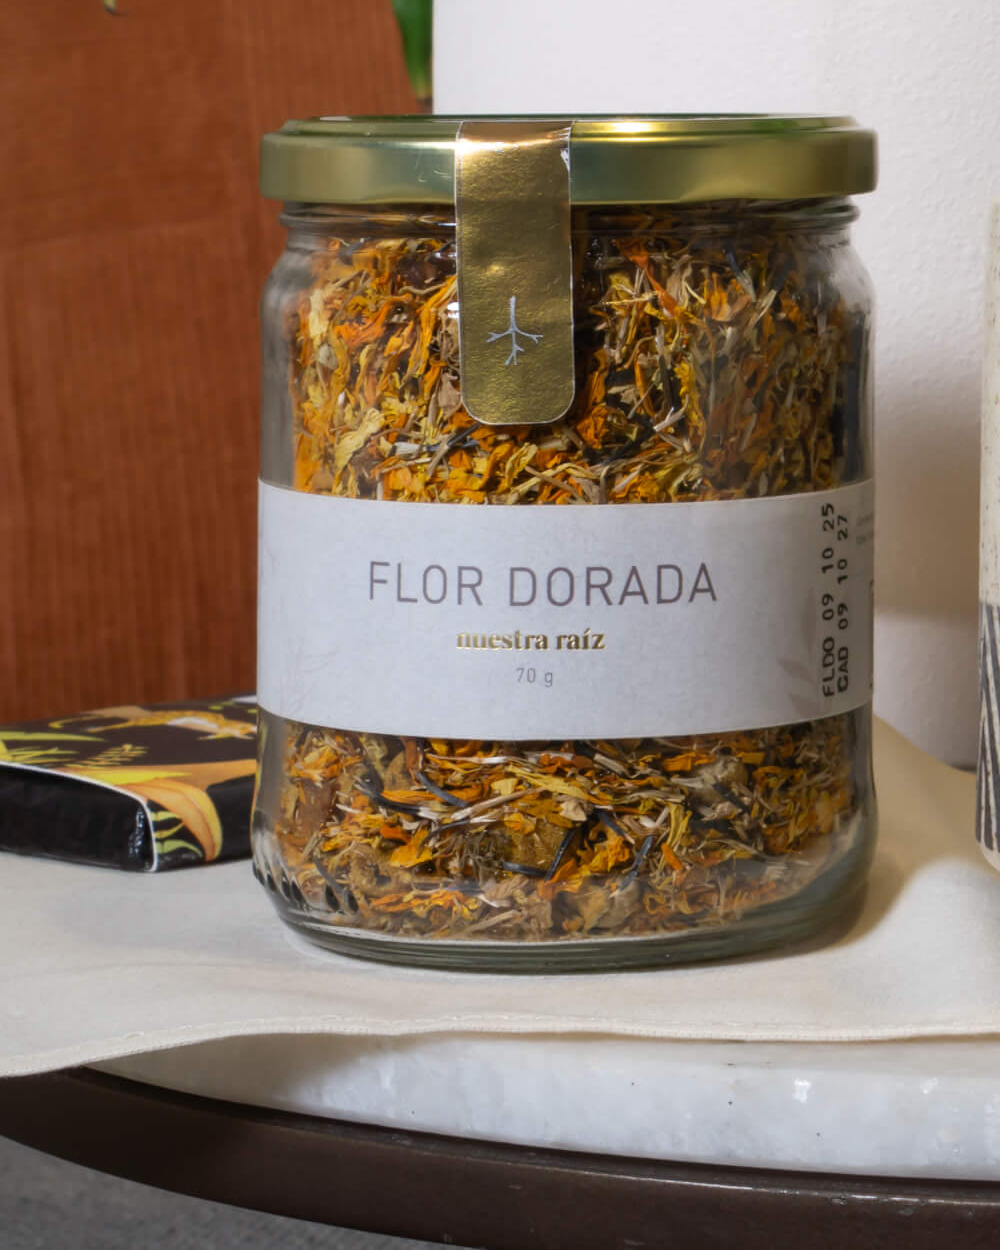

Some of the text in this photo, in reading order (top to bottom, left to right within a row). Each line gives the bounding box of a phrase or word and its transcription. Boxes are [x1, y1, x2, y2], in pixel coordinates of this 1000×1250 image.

[821, 502, 835, 532] 25
[821, 547, 835, 574] 10
[368, 560, 719, 607] FLOR DORADA
[821, 593, 835, 621] 09
[837, 515, 849, 693] CAD 09 10 27
[454, 626, 607, 651] nuestra raíz
[515, 666, 554, 688] 70 g
